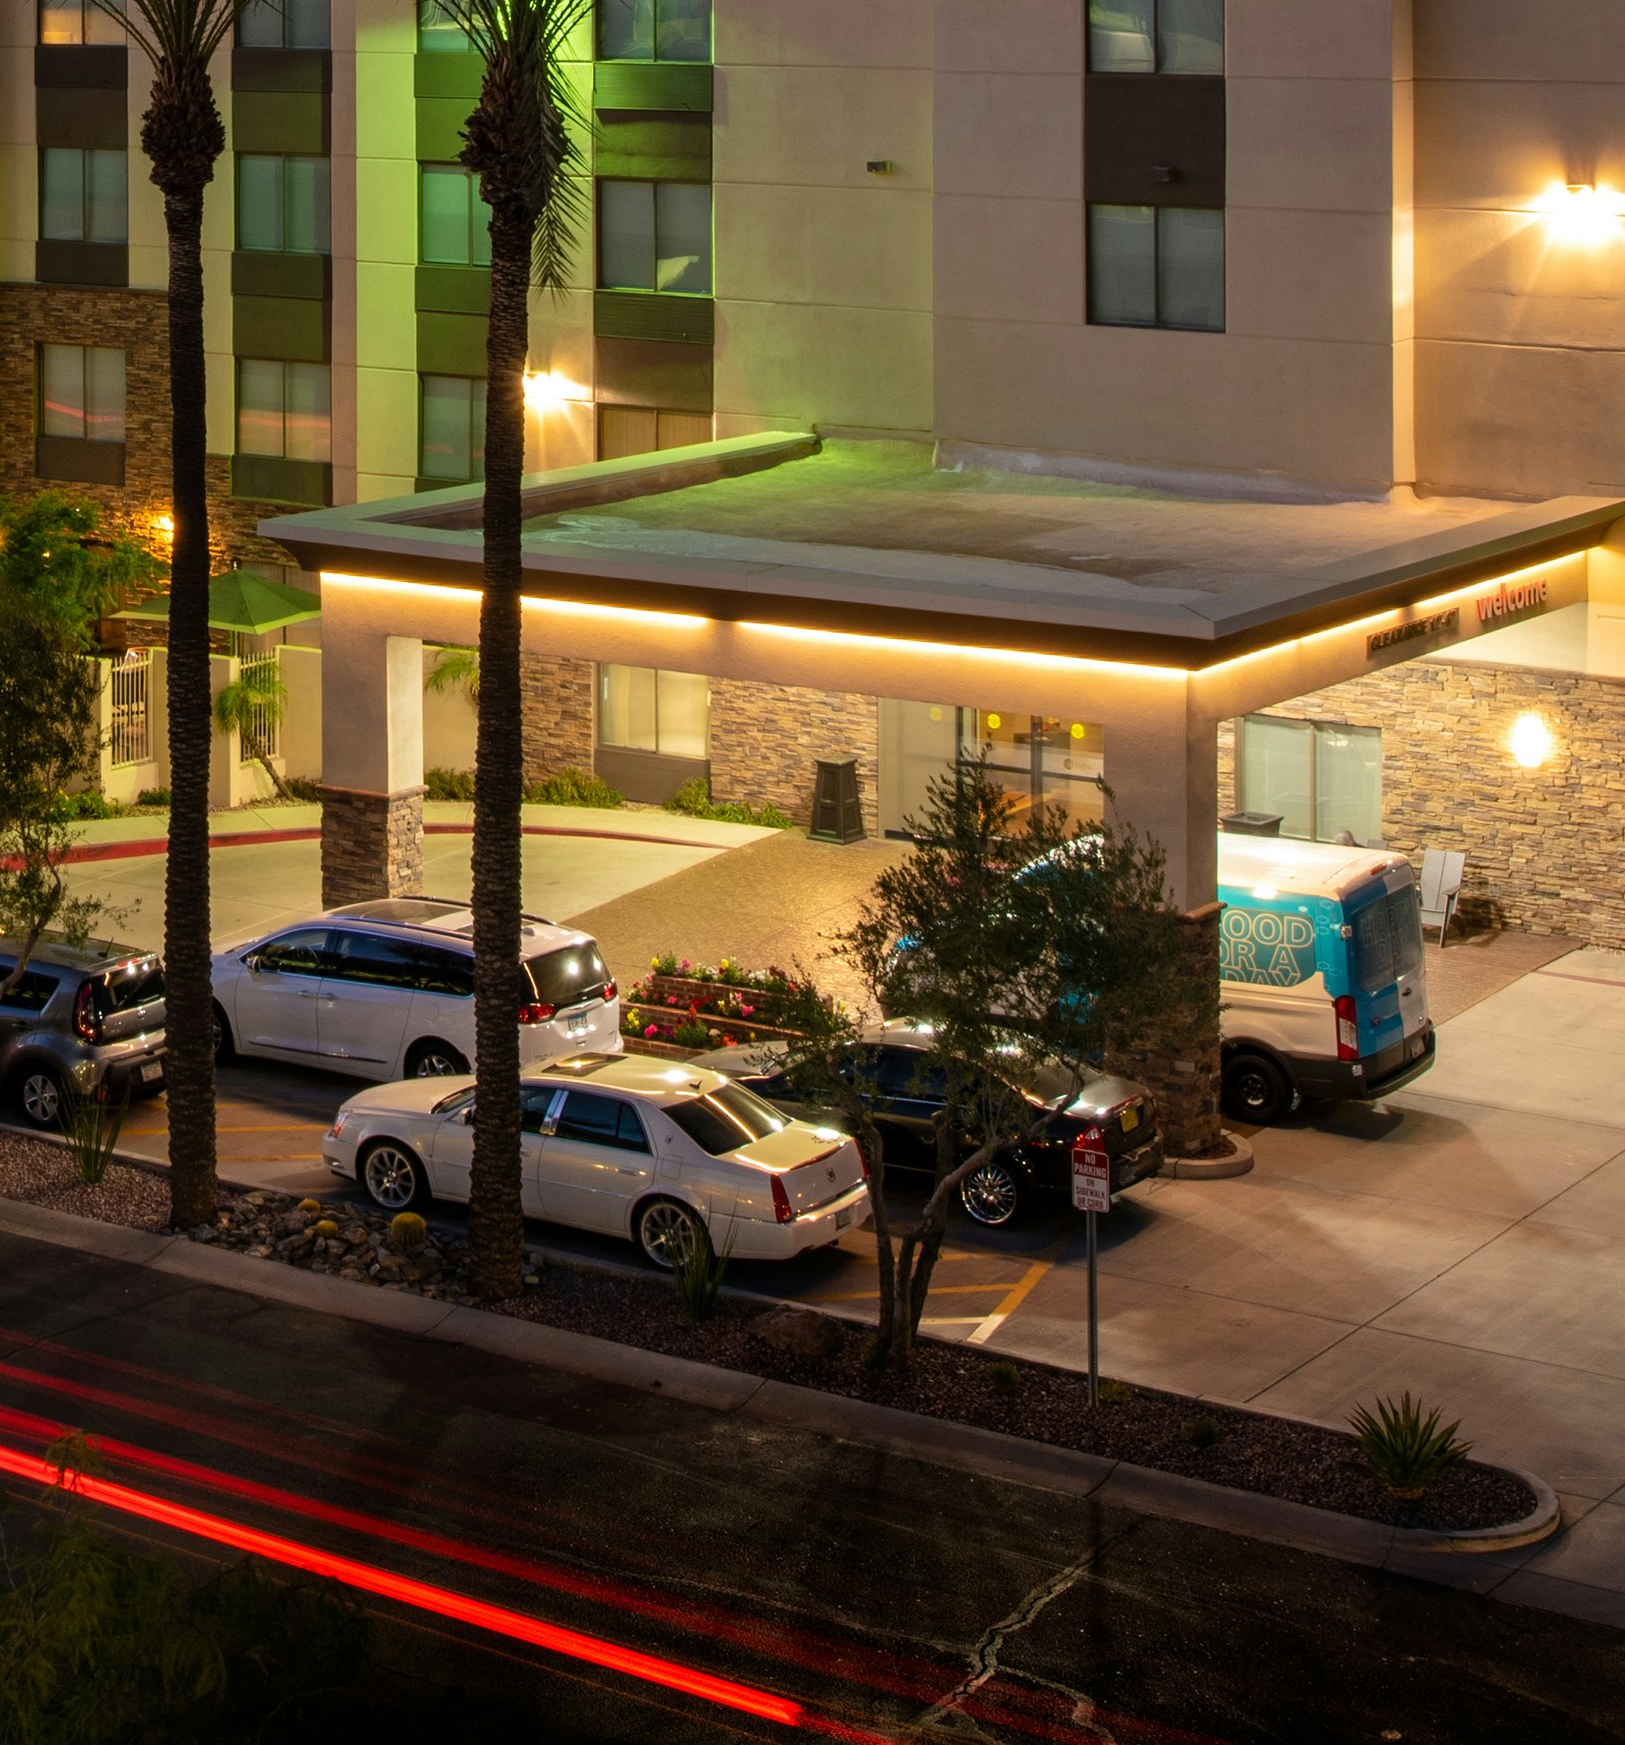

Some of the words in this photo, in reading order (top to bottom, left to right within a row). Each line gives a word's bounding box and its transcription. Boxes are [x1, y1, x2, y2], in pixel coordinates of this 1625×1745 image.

[1476, 579, 1548, 622] welcome
[1220, 909, 1315, 948] OOD
[1268, 943, 1301, 975] A
[1084, 1153, 1096, 1165] NO
[1074, 1162, 1107, 1179] PARKING
[1085, 1177, 1095, 1187] ON
[1075, 1185, 1106, 1200] SIDEWALK
[1077, 1196, 1086, 1206] OR
[1086, 1198, 1104, 1209] CURB
